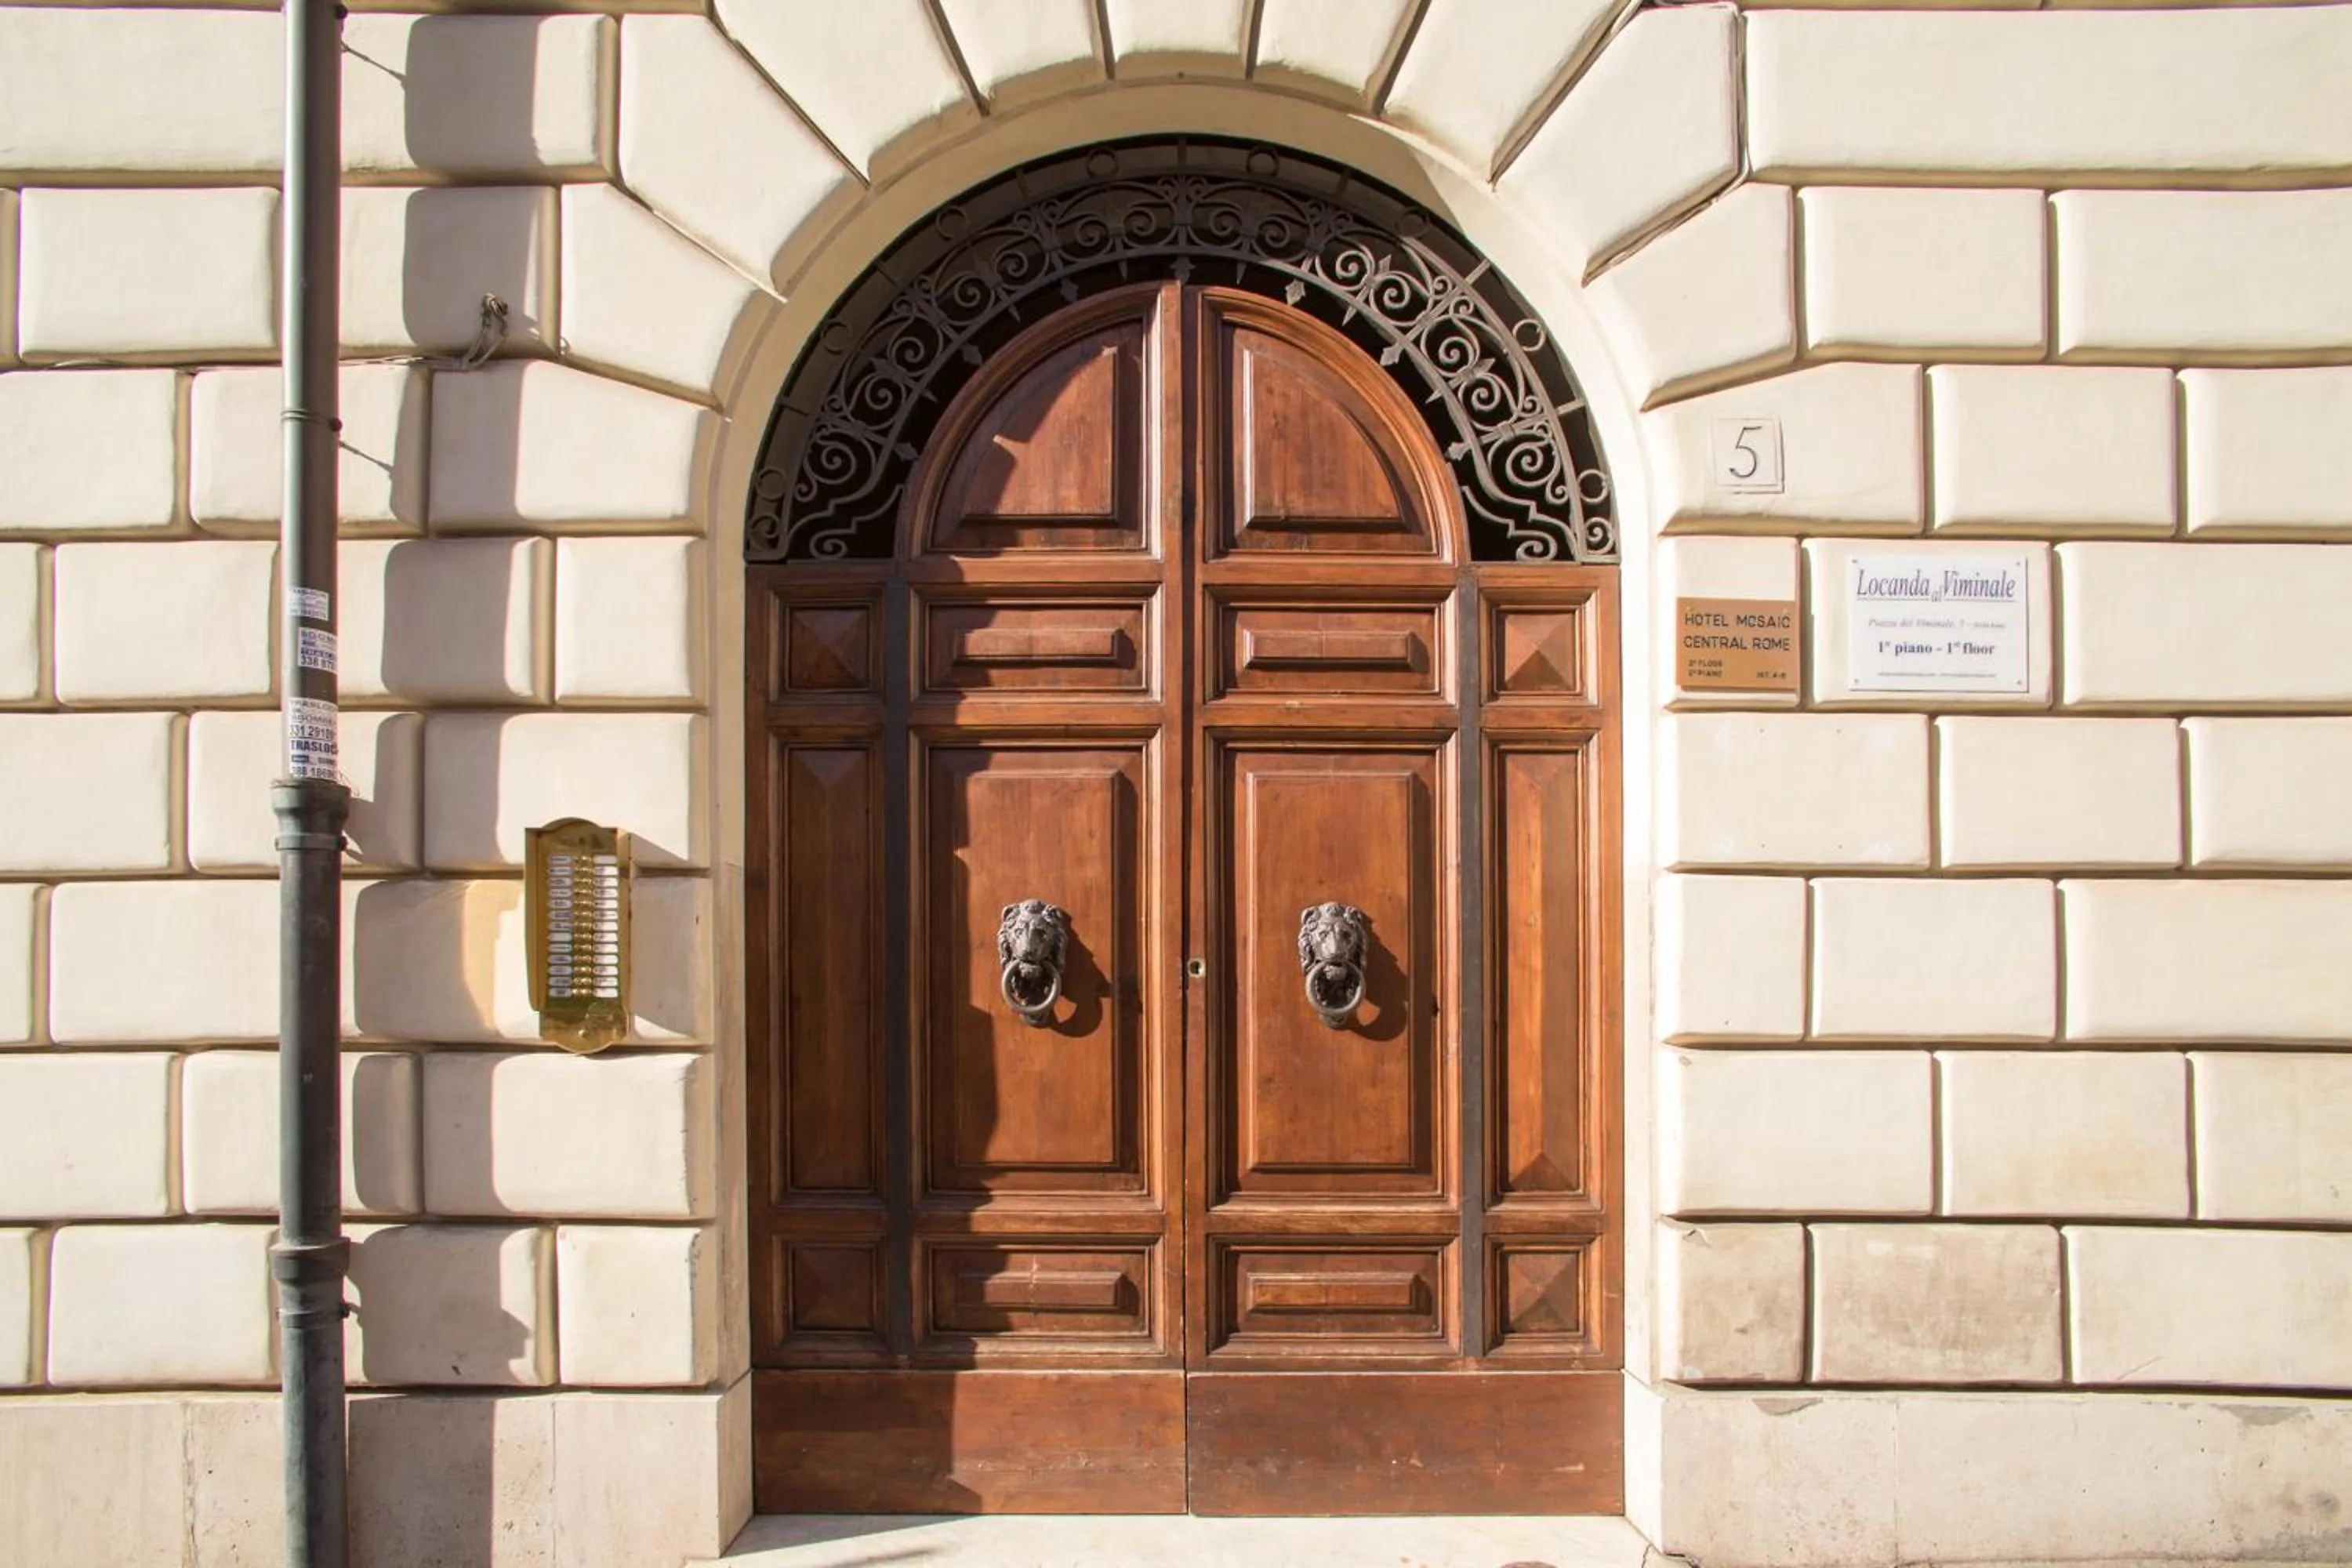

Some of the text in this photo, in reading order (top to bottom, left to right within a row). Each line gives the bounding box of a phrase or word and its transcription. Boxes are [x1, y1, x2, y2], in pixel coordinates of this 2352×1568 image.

[1728, 425, 1763, 479] 5
[1856, 568, 2016, 603] Locanda al Viminale
[1685, 612, 1791, 628] HOTEL MOSAIC
[1868, 618, 1898, 628] Piazza
[1683, 635, 1791, 652] CENTRAL ROME
[1895, 641, 1933, 656] piano
[1962, 641, 1995, 655] floor
